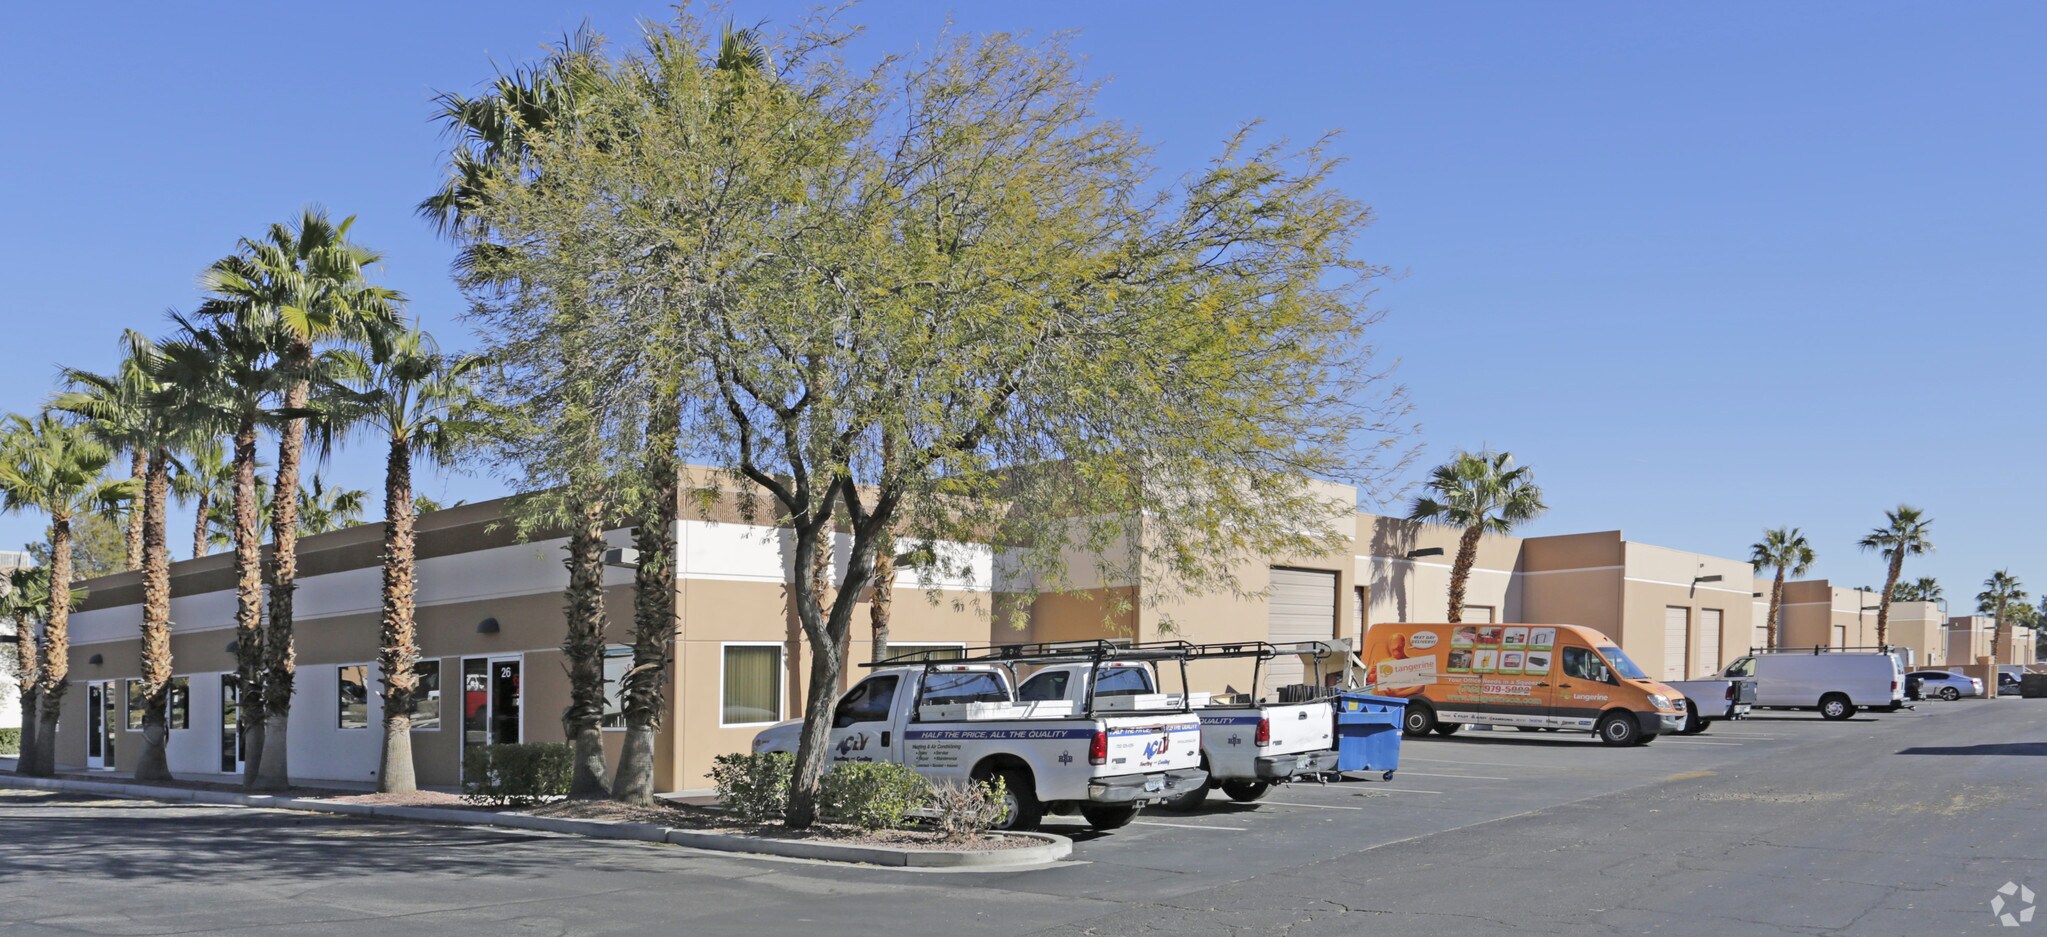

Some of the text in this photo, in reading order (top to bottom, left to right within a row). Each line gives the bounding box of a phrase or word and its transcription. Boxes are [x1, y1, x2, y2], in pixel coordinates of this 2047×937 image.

[501, 666, 511, 678] 26
[1395, 661, 1435, 673] tangerine
[1573, 693, 1609, 702] tangerine
[921, 730, 1068, 739] HALF THE PRICE, ALL THE QUALITY
